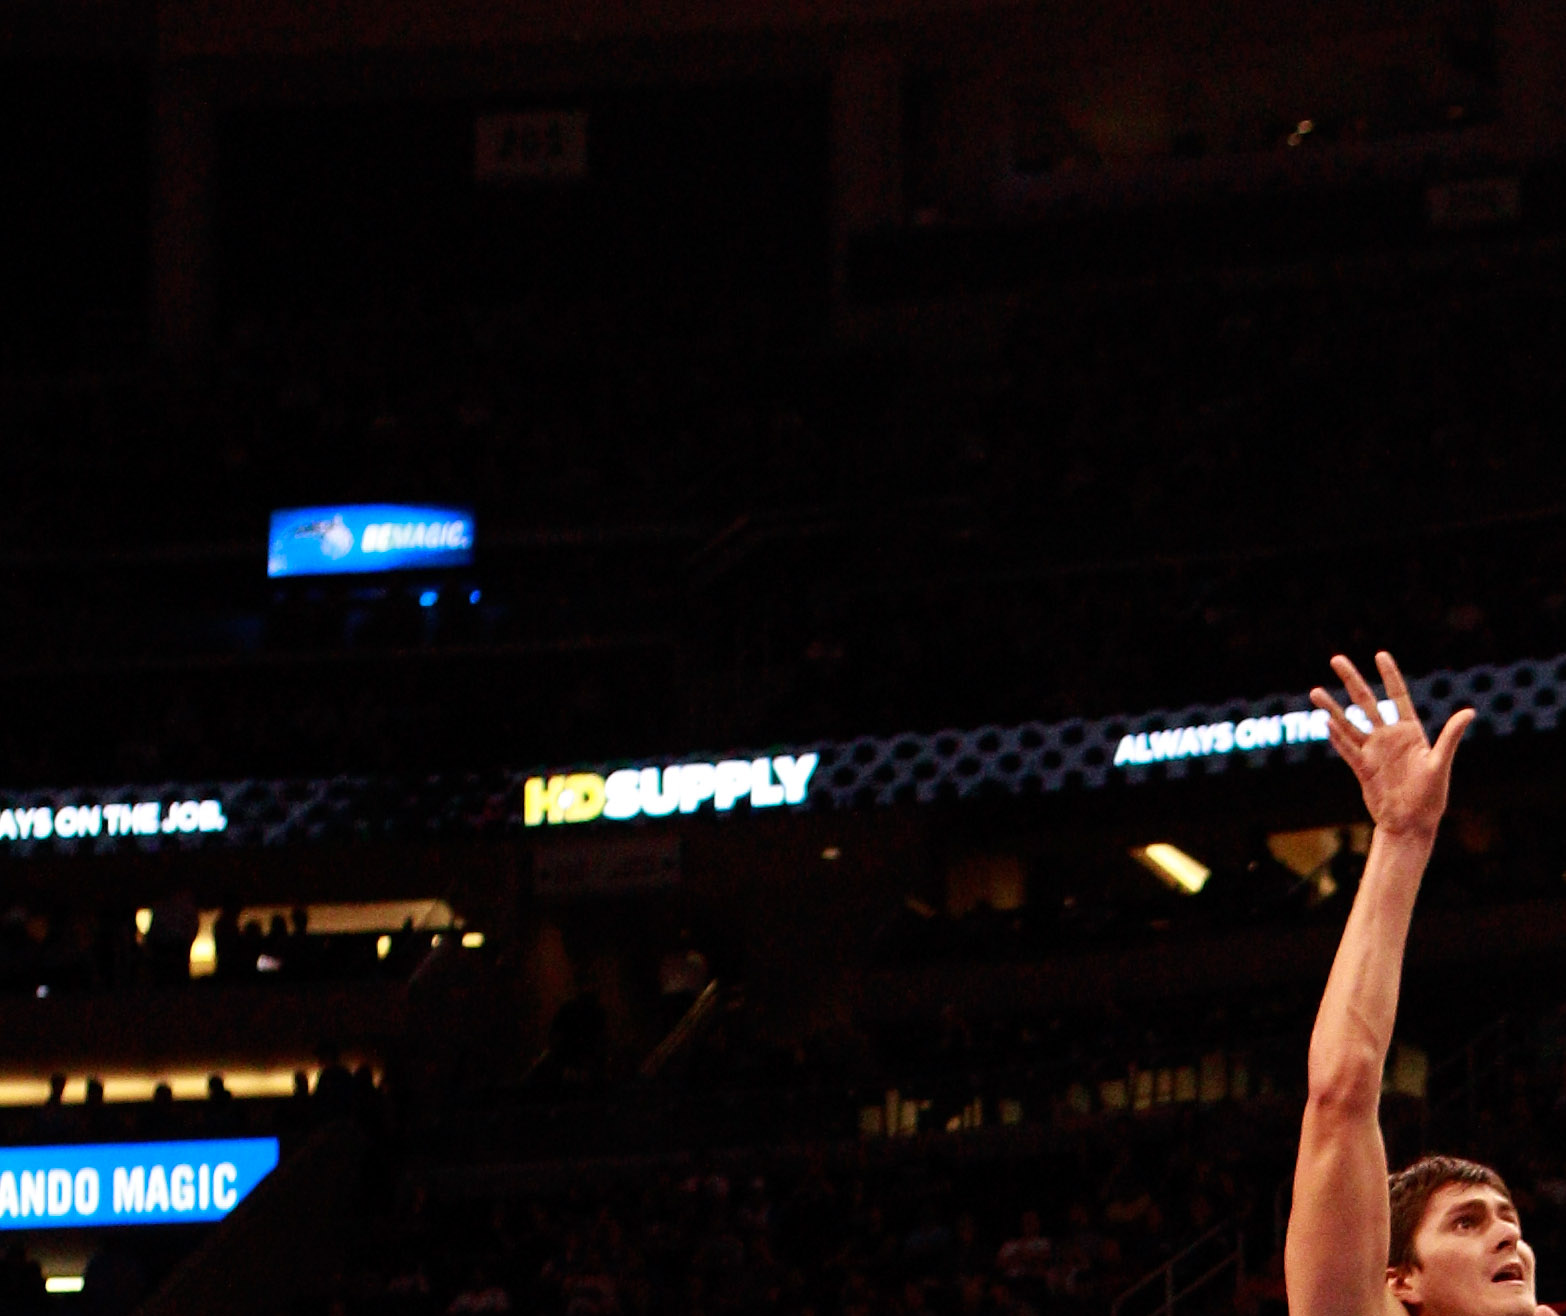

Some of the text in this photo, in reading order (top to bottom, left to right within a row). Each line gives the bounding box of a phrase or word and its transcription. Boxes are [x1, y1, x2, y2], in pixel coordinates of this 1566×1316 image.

[1112, 721, 1235, 768] ALWAYS
[1235, 713, 1282, 751] ON
[54, 806, 101, 838] ON
[103, 802, 161, 836] THE
[112, 1160, 238, 1215] MAGIC
